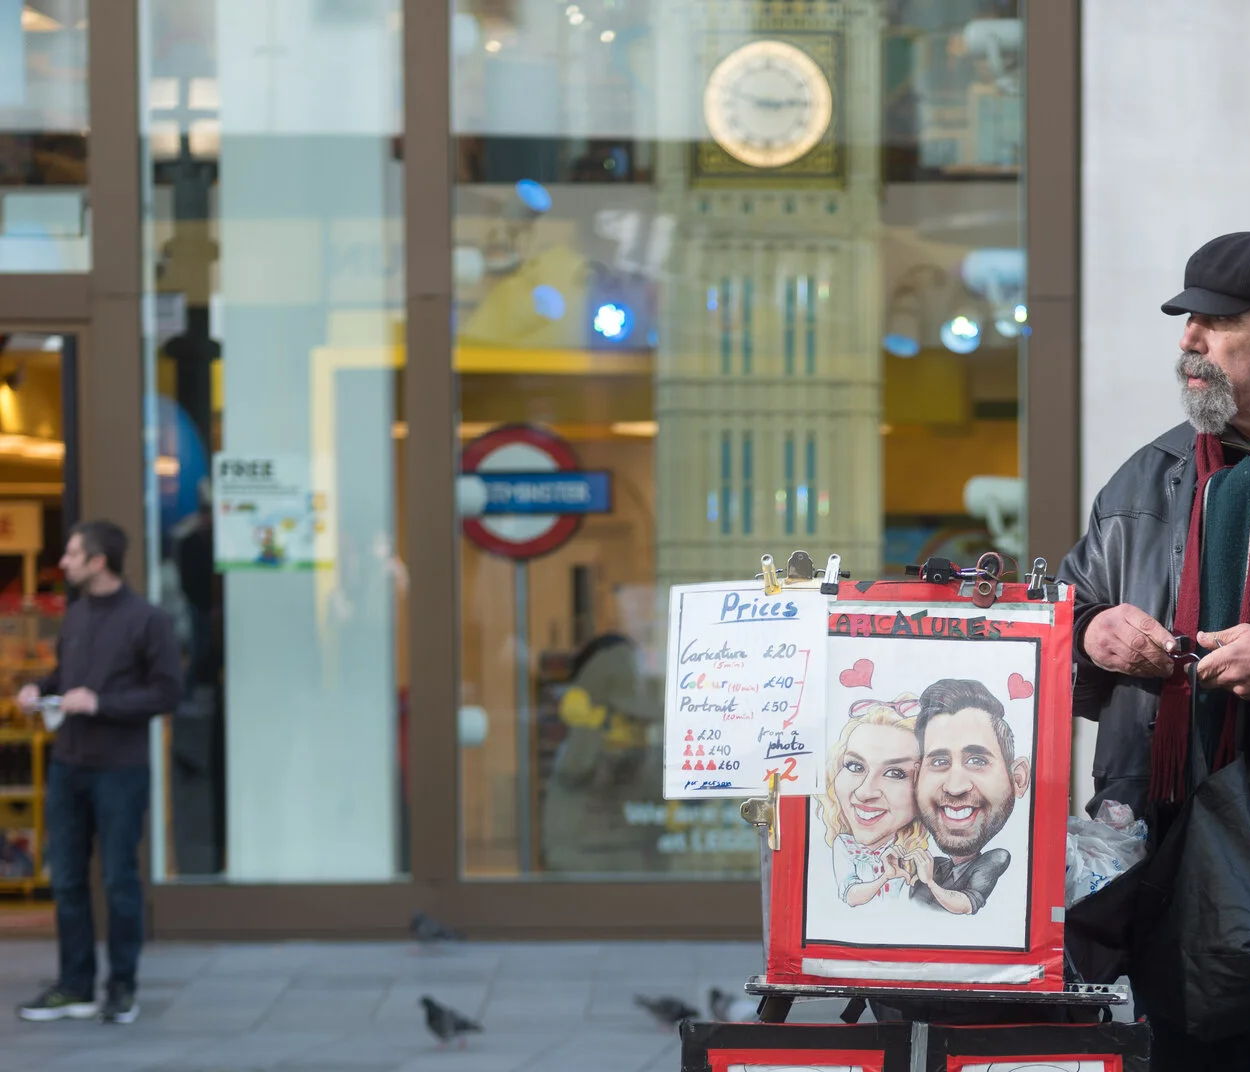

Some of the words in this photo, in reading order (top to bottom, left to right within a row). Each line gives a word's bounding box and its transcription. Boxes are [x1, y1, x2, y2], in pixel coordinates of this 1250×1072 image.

[720, 592, 798, 620] Prices
[834, 609, 1002, 640] ARICATURES
[681, 639, 748, 664] Caricature
[763, 643, 797, 658] £20
[680, 672, 728, 689] Colour
[763, 676, 794, 689] £40
[680, 696, 738, 713] Portrait
[762, 700, 788, 713] £50
[697, 729, 721, 741] £20
[757, 727, 784, 742] from
[708, 745, 731, 756] £40
[767, 736, 805, 758] photo
[718, 760, 740, 771] £60
